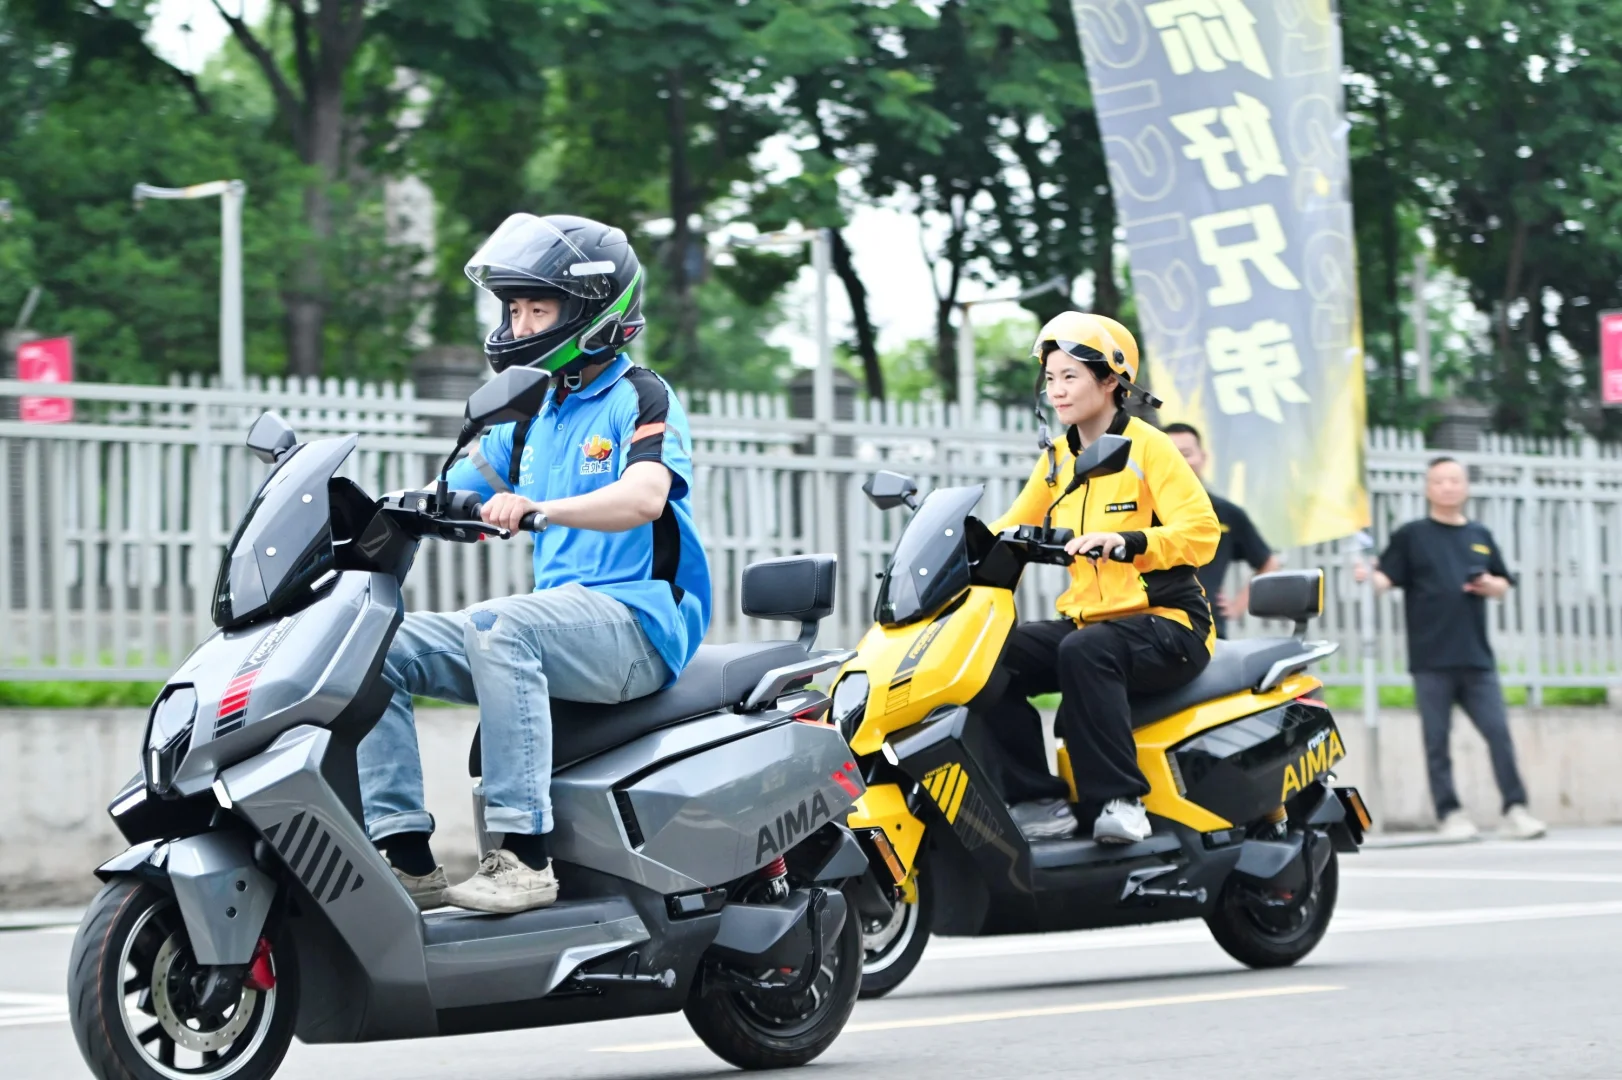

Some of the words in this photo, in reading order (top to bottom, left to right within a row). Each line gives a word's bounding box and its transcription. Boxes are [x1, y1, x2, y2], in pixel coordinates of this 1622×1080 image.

[580, 461, 611, 474] 点外卖
[1281, 729, 1346, 803] AIMA
[755, 789, 830, 865] AIMA
